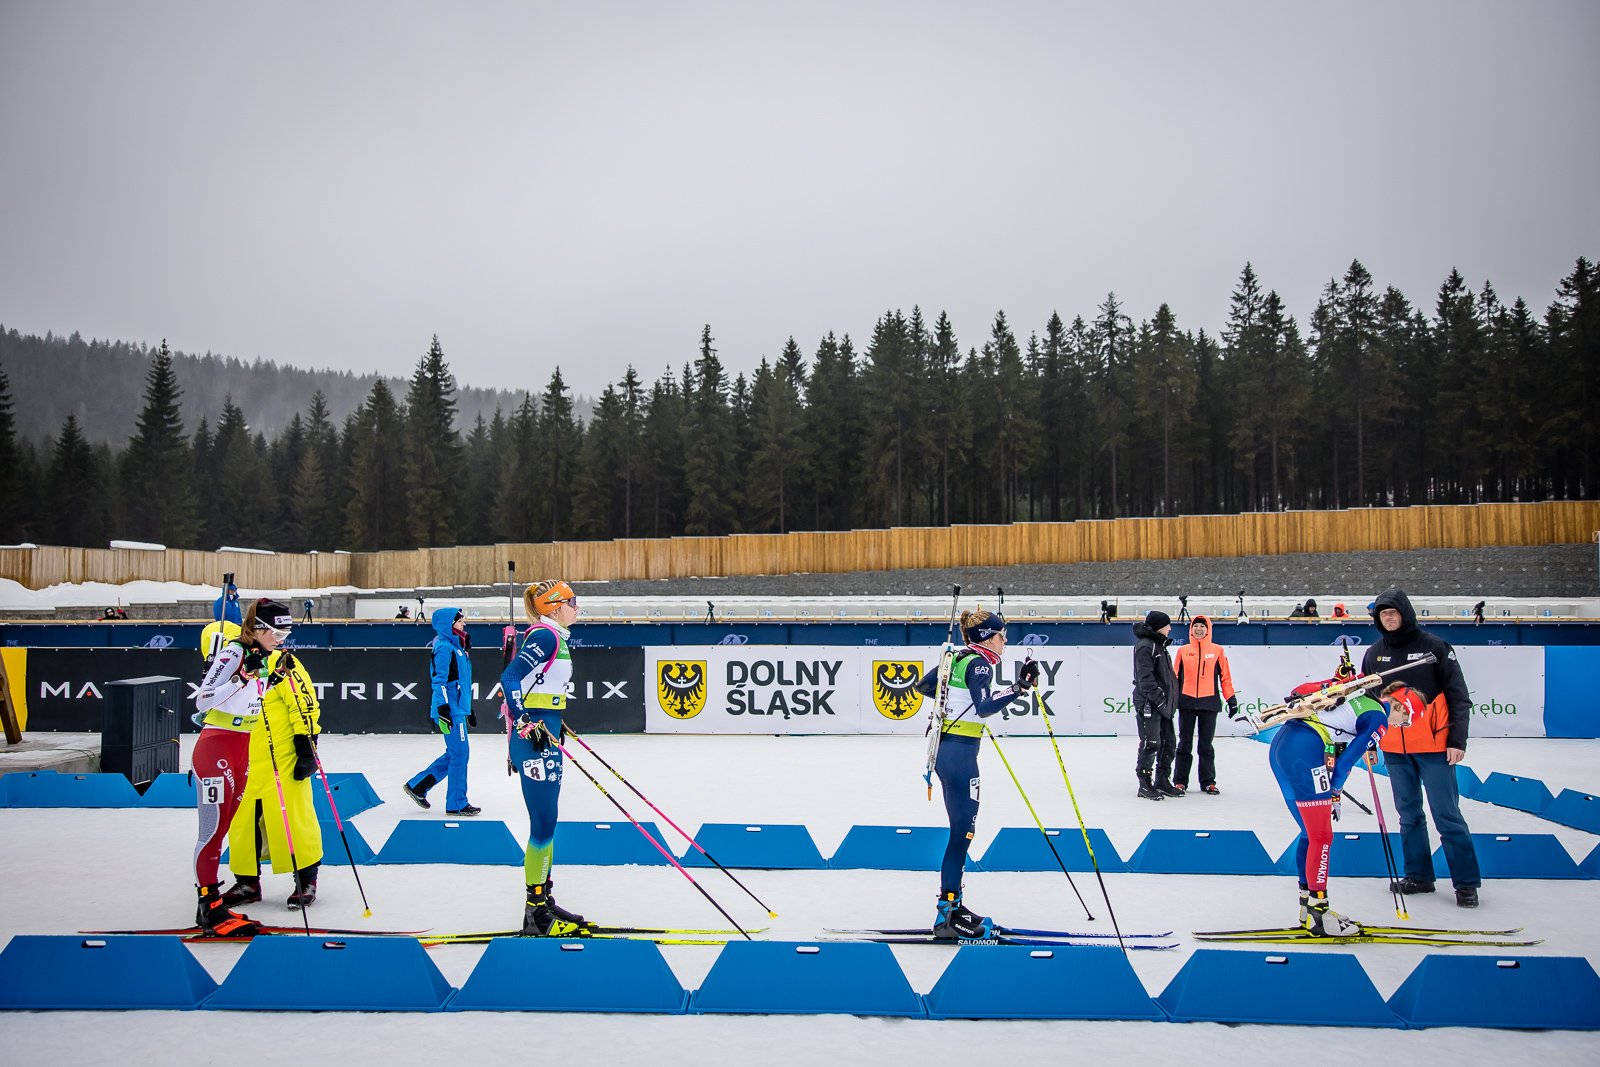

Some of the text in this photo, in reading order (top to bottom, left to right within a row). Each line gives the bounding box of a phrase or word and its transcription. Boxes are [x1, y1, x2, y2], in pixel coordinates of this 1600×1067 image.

[206, 664, 225, 687] helvetia
[535, 673, 544, 685] 8
[726, 660, 843, 686] DOLNY
[974, 666, 989, 674] EA7
[995, 660, 1063, 686] LNY
[292, 671, 314, 714] HEAD
[315, 683, 418, 699] TRIX
[725, 684, 836, 720] ŚLĄSK
[1471, 698, 1517, 718] ręba
[223, 768, 235, 793] Sunr
[1319, 775, 1328, 791] 6
[208, 786, 218, 803] 9
[540, 855, 549, 884] LOVENIA
[1316, 844, 1329, 884] SLOVAKIA
[1332, 936, 1374, 944] FISCHER
